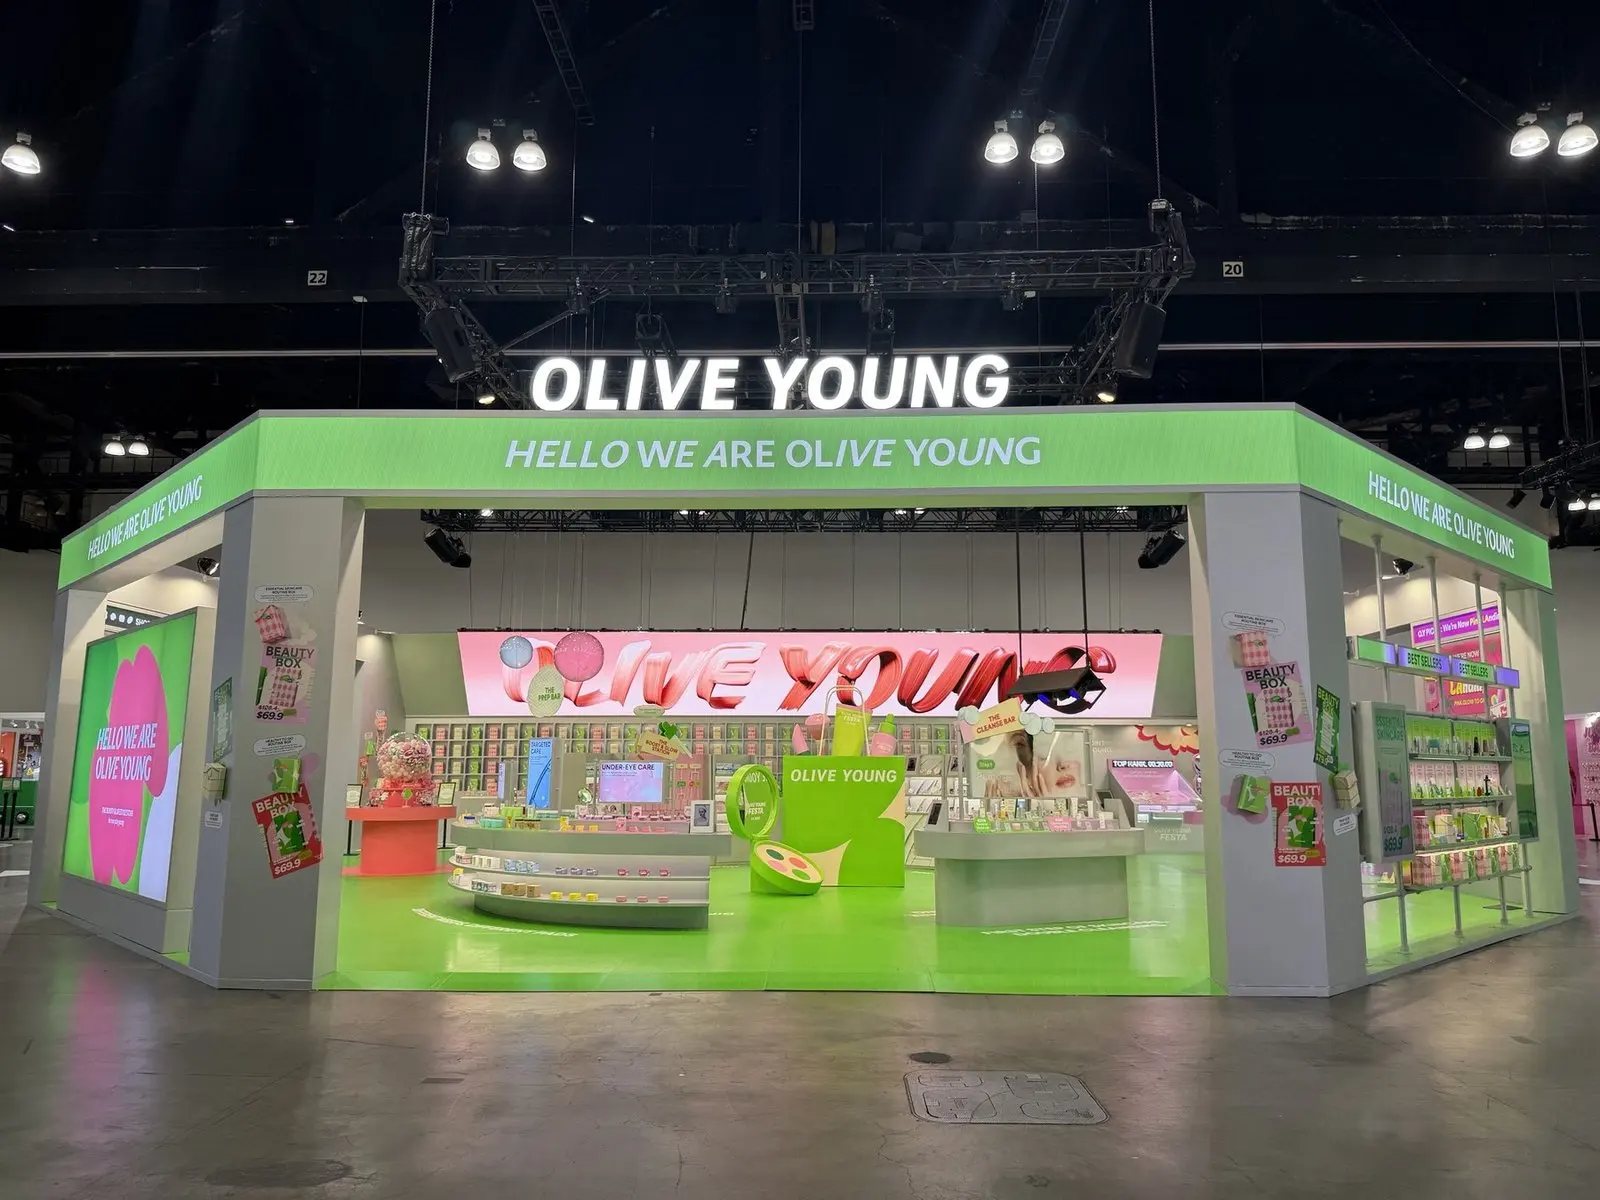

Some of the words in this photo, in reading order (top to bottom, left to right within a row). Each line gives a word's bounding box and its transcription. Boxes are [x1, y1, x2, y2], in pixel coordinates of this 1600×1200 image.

[1224, 264, 1242, 274] 20
[309, 272, 326, 284] 22
[532, 356, 740, 412] OLIVE
[764, 354, 1010, 410] YOUNG
[505, 440, 630, 468] HELLO
[637, 440, 699, 468] WE
[703, 439, 776, 467] ARE
[787, 439, 896, 467] OLIVE
[904, 436, 1041, 466] YOUNG
[88, 530, 110, 560] HELLO
[110, 524, 124, 548] WE
[123, 512, 140, 543] ARE
[140, 497, 167, 532] OLIVE
[167, 475, 203, 516] YOUNG
[1368, 471, 1409, 512] HELLO
[1410, 490, 1430, 522] WE
[1432, 502, 1452, 532] ARE
[1454, 512, 1482, 545] OLIVE
[1483, 526, 1515, 558] YOUNG
[1458, 620, 1470, 628] Now
[266, 646, 314, 659] BEAUTY
[276, 658, 302, 669] BOX
[1408, 652, 1420, 666] BEST
[1421, 655, 1442, 670] SELLERS
[1245, 664, 1296, 681] BEAUTY
[1459, 662, 1470, 674] BEST
[1470, 664, 1488, 678] SELLERS
[1260, 676, 1287, 690] BOX
[538, 692, 550, 700] PREP
[256, 711, 284, 720] $69.9
[988, 714, 1000, 722] THE
[976, 720, 1004, 734] CLEANSE
[1004, 716, 1016, 725] BAR
[96, 726, 124, 750] HELLO
[124, 724, 139, 750] WE
[139, 722, 158, 749] ARE
[1260, 734, 1288, 746] $69.9
[96, 756, 120, 780] OLIVE
[120, 755, 152, 781] YOUNG
[790, 769, 836, 782] OLIVE
[843, 769, 897, 783] YOUNG
[1286, 796, 1314, 808] BOX
[270, 802, 297, 818] BOX
[1277, 854, 1307, 864] $69.9
[274, 859, 301, 875] $69.9
